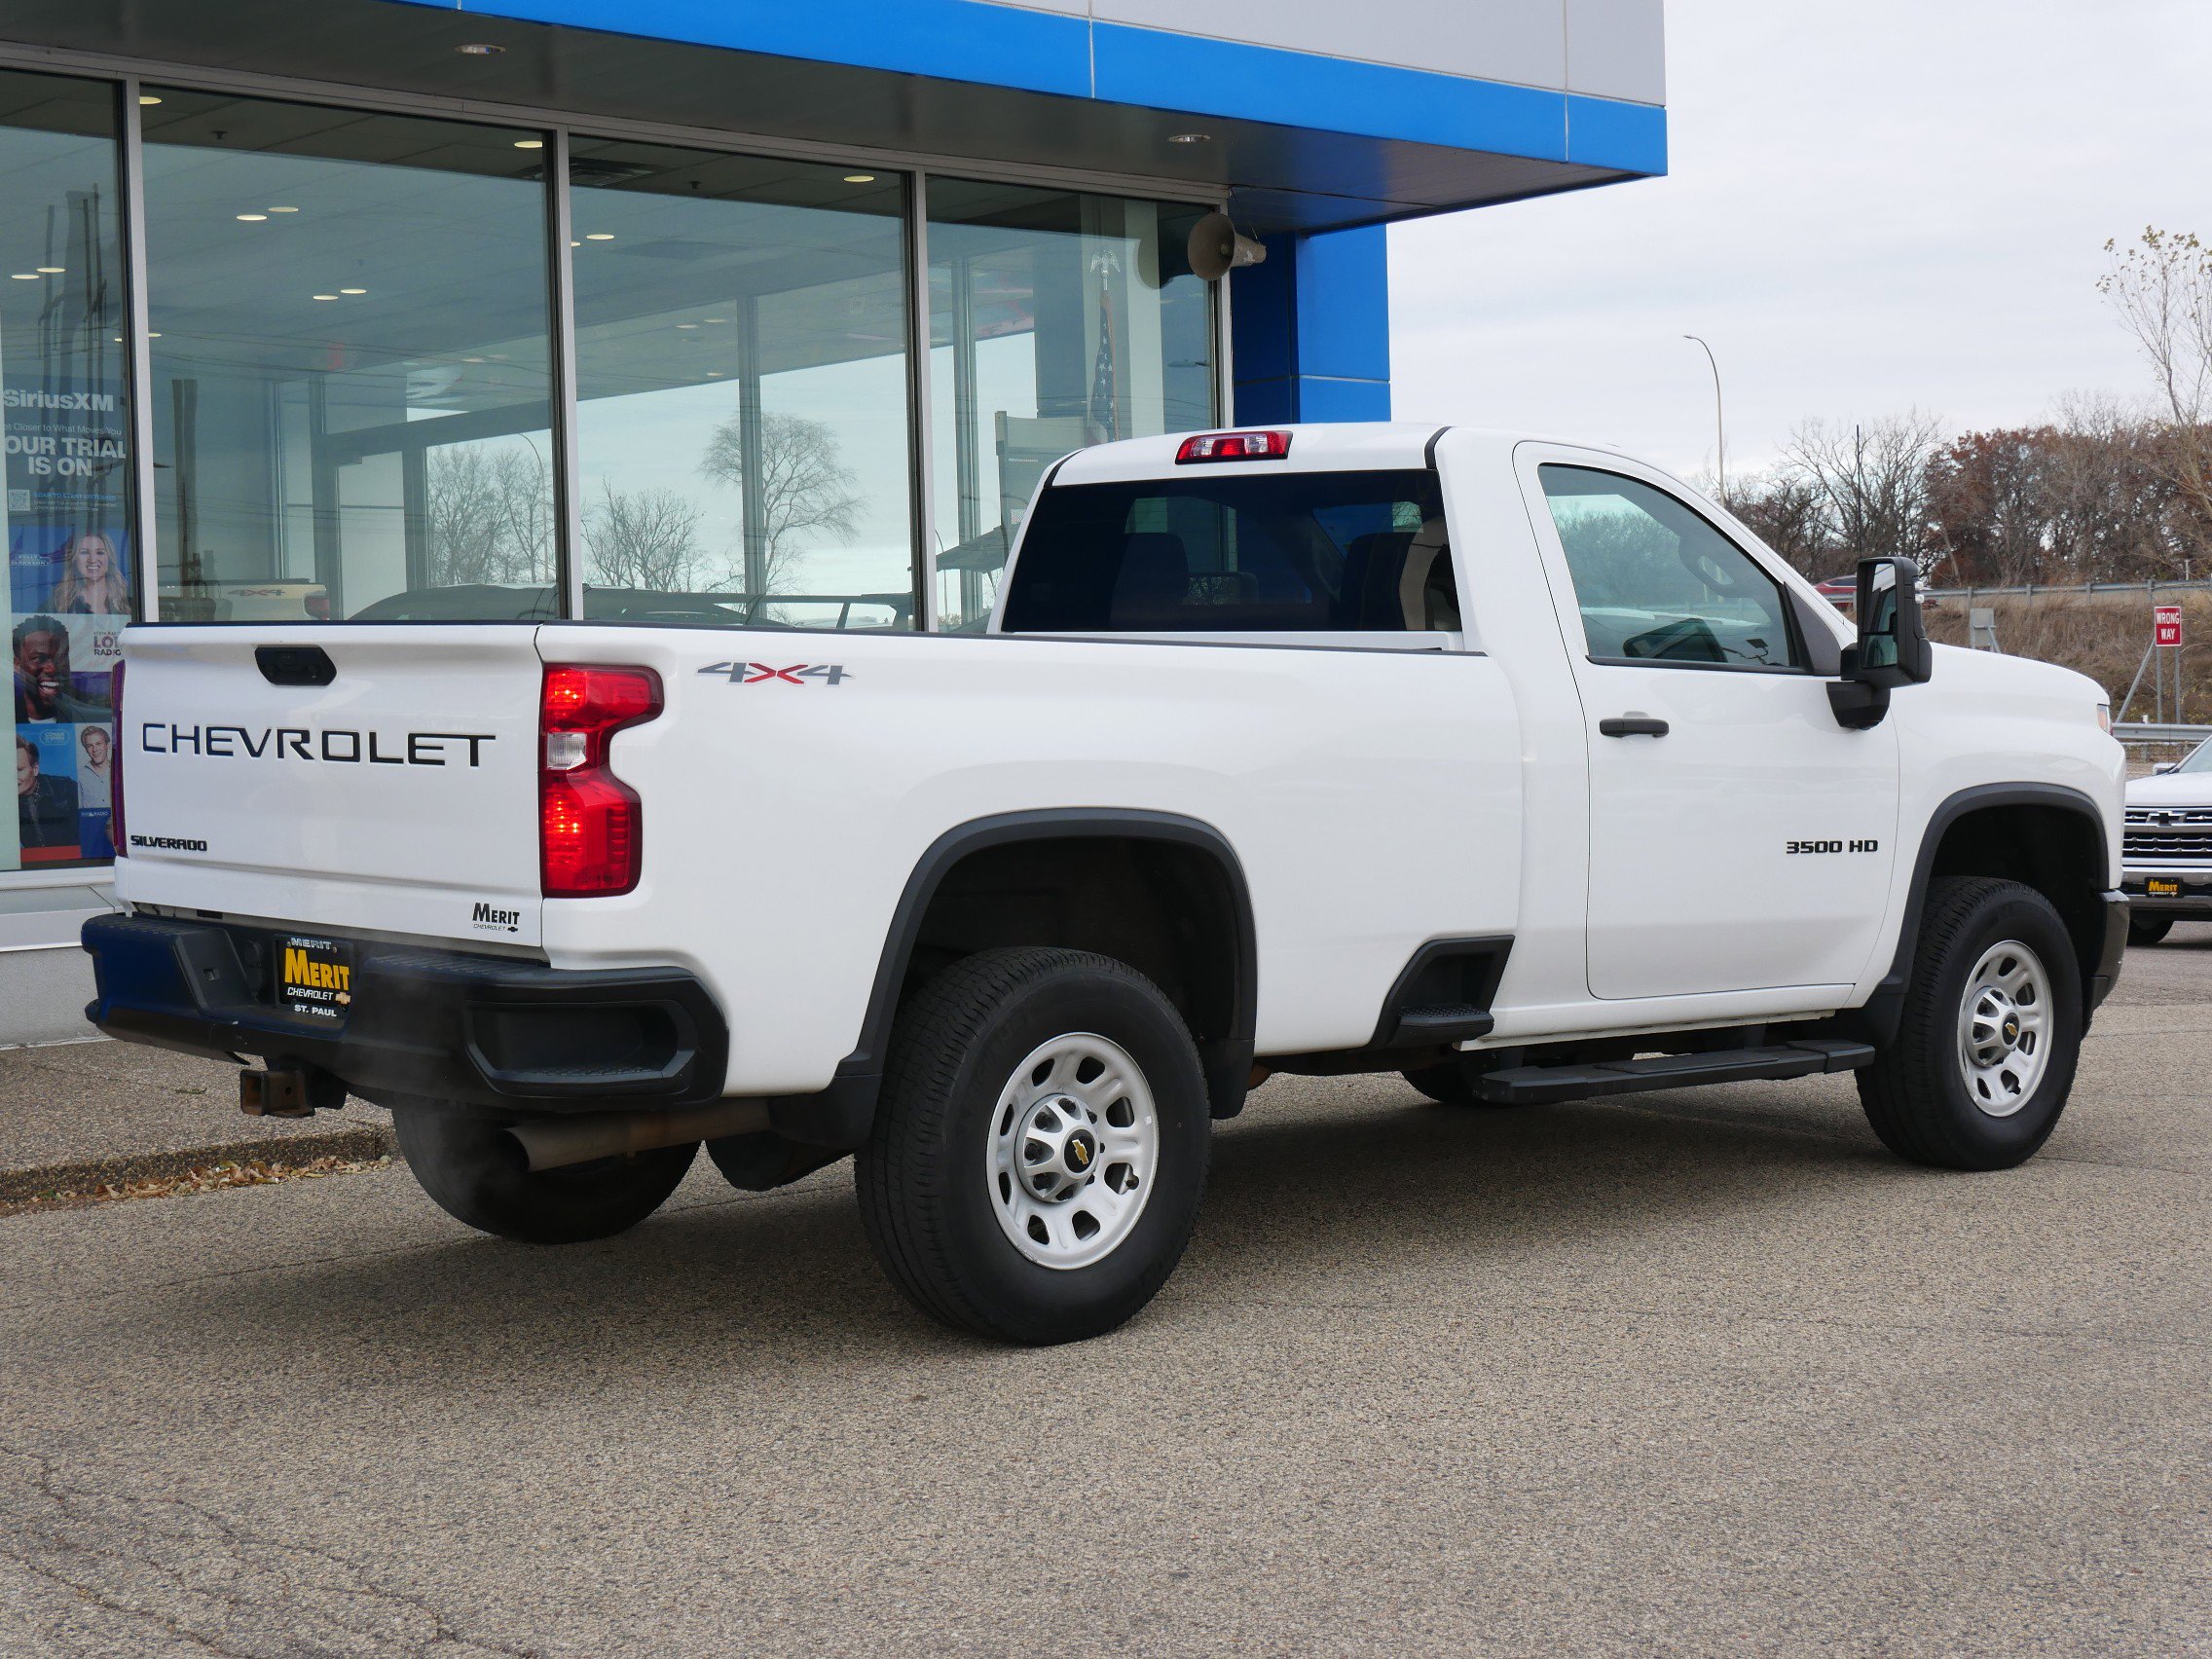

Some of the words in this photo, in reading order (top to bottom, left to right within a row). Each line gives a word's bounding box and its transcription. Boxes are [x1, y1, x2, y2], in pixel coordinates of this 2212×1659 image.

[4, 389, 114, 412] SiriusXM
[55, 424, 76, 433] What
[5, 435, 56, 456] OUR
[61, 437, 127, 460] TRIAL
[28, 456, 52, 475] IS
[57, 457, 92, 477] ON
[2156, 612, 2180, 625] WRONG
[2160, 628, 2176, 641] WAY
[697, 661, 853, 685] 4X4
[142, 722, 498, 768] CHEVROLET
[130, 834, 208, 852] SILVERADO
[1786, 840, 1843, 854] 3500
[1849, 839, 1879, 853] HD
[2148, 880, 2178, 892] MERIT
[472, 902, 521, 925] MERIT
[290, 937, 332, 950] MERIT
[284, 947, 350, 991] MERIT
[286, 986, 334, 1001] CHEVROLET
[294, 1004, 310, 1014] ST.
[312, 1006, 338, 1018] PAUL
